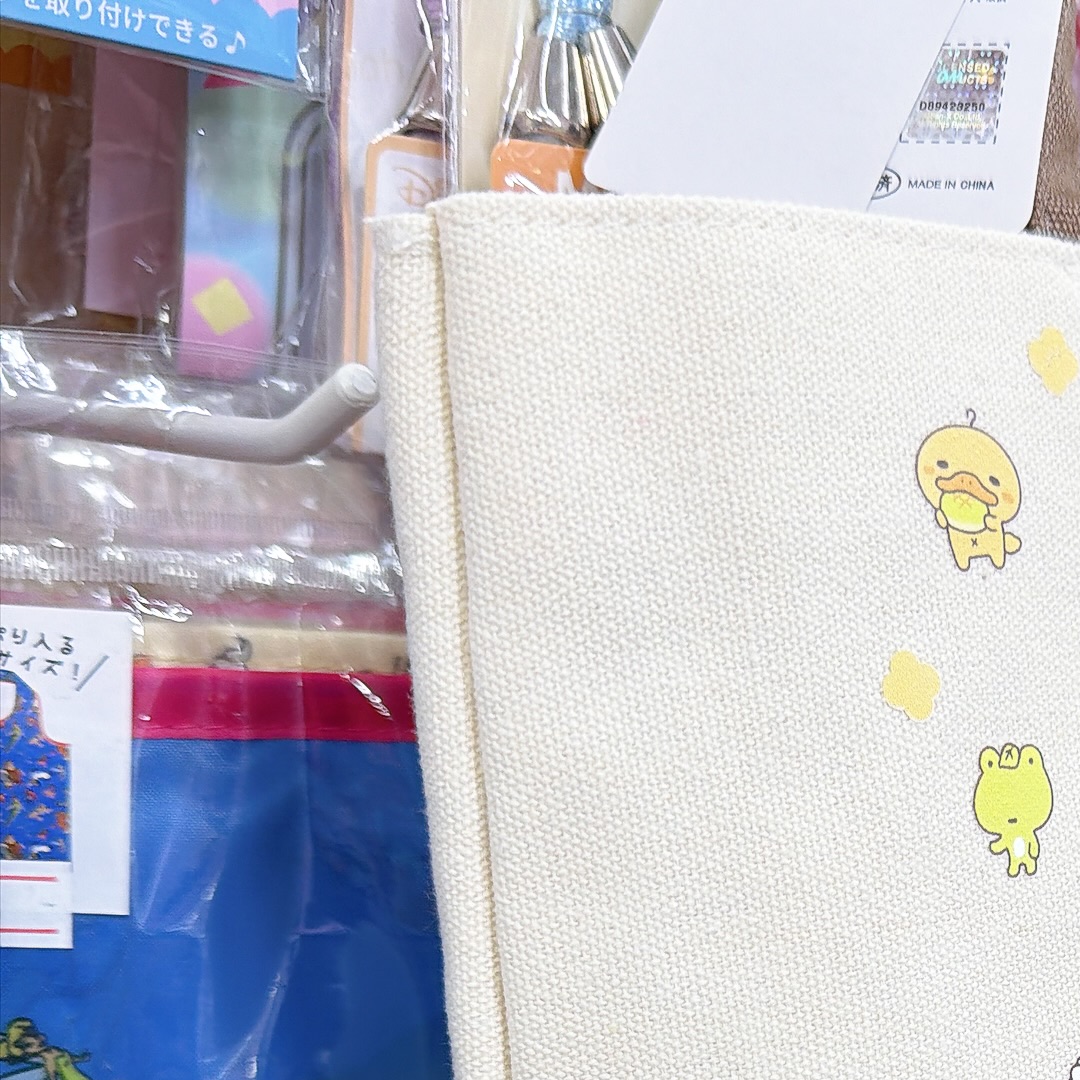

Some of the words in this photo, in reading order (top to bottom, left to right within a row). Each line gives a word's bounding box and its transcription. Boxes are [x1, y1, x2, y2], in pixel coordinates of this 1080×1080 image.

[907, 178, 941, 190] MADE
[944, 179, 957, 190] IN
[960, 180, 995, 191] CHINA
